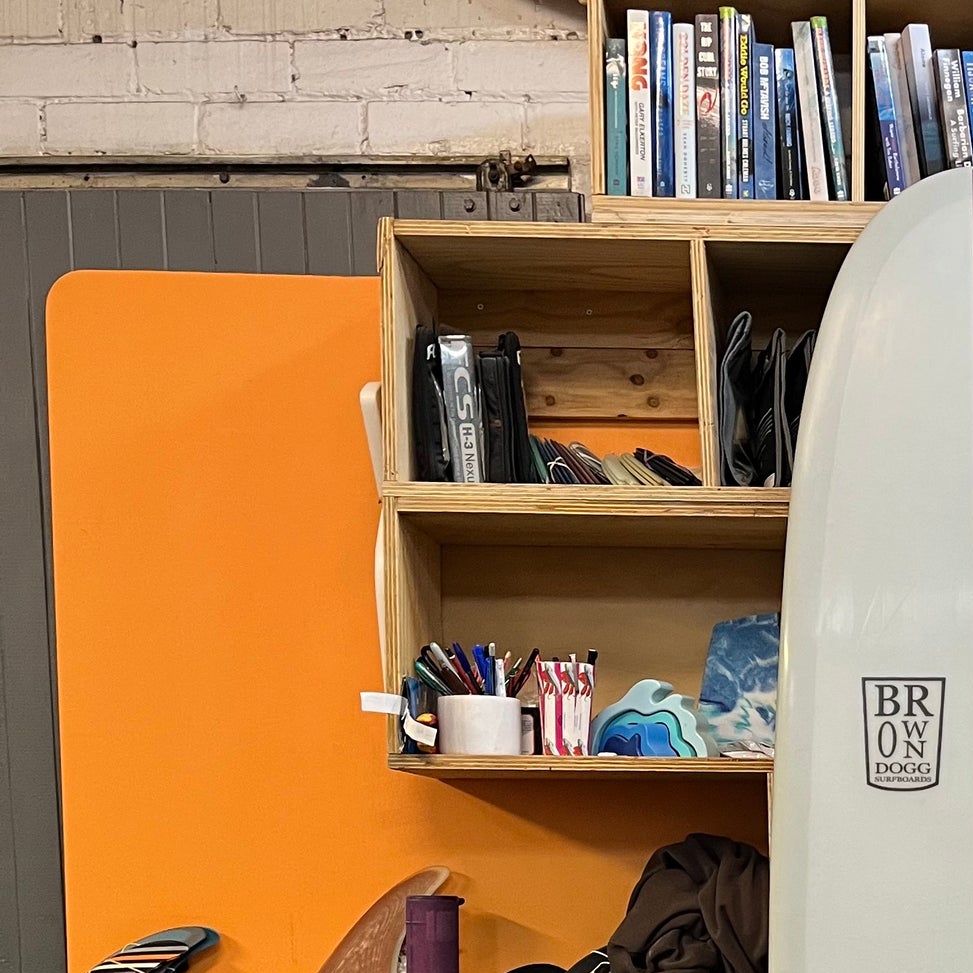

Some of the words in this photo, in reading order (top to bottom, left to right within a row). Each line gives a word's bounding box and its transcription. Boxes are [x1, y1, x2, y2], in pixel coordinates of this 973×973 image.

[631, 22, 648, 91] KONG
[760, 56, 769, 75] BOB
[740, 66, 748, 99] Would
[942, 58, 954, 102] Finnegan
[951, 60, 961, 98] William
[740, 100, 748, 115] Go
[951, 128, 960, 158] Surfing
[956, 109, 970, 158] Barbarian
[461, 426, 474, 449] H-3
[875, 762, 932, 775] DOGG
